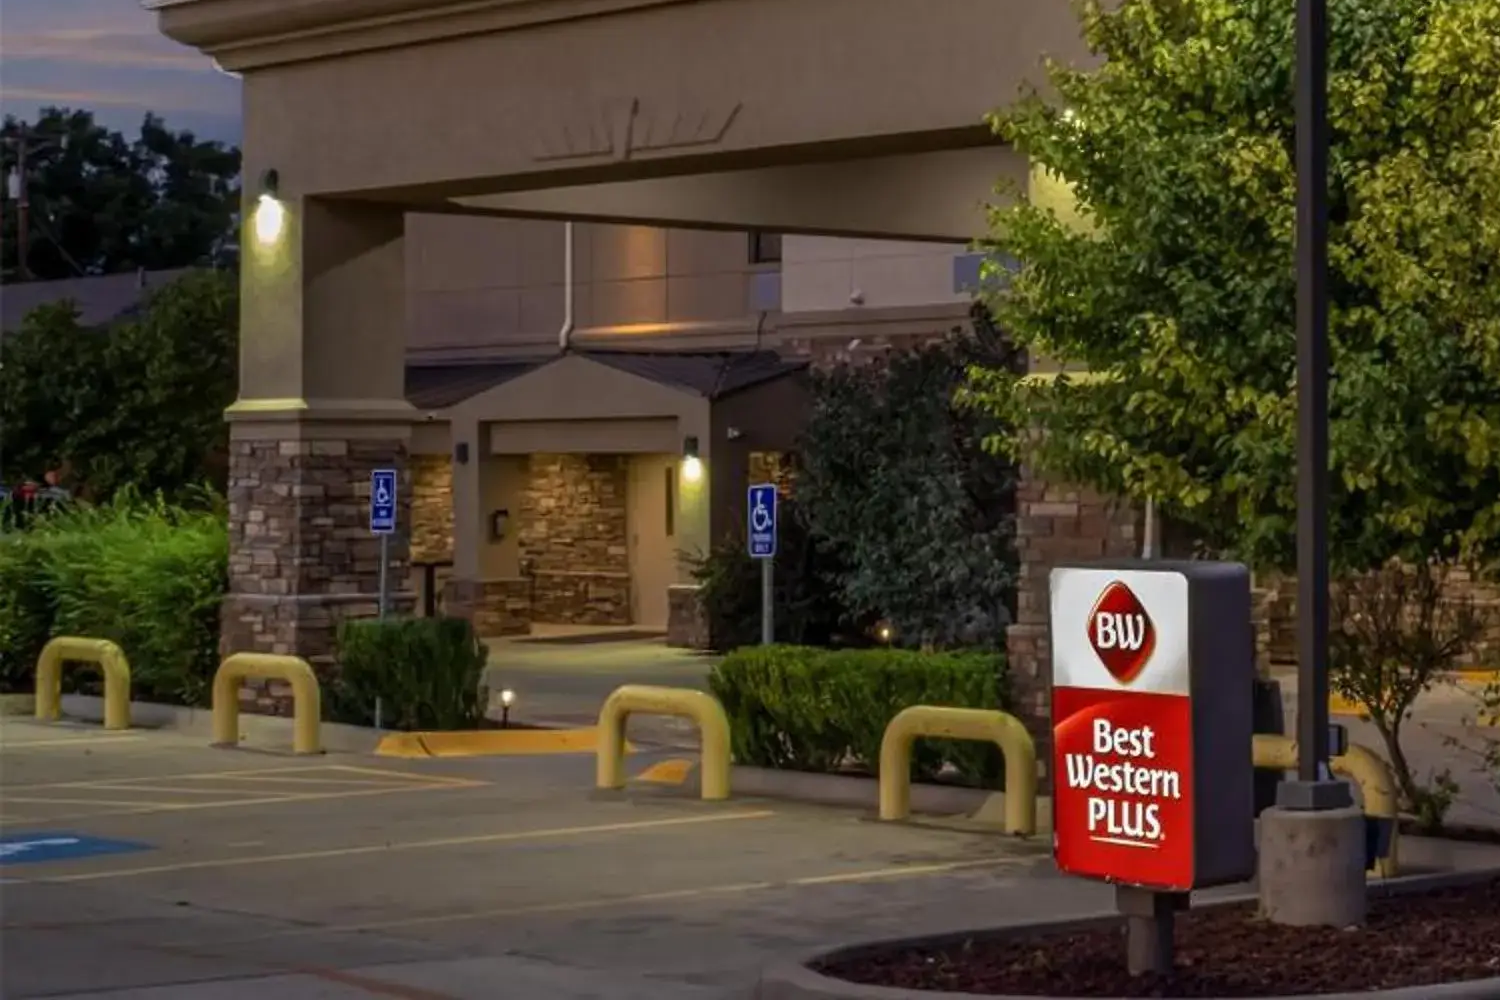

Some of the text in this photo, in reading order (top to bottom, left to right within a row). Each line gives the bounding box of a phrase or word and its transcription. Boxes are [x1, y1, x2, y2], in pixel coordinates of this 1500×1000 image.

[1096, 611, 1146, 651] BW
[1092, 718, 1155, 759] Best
[1065, 753, 1181, 799] Western
